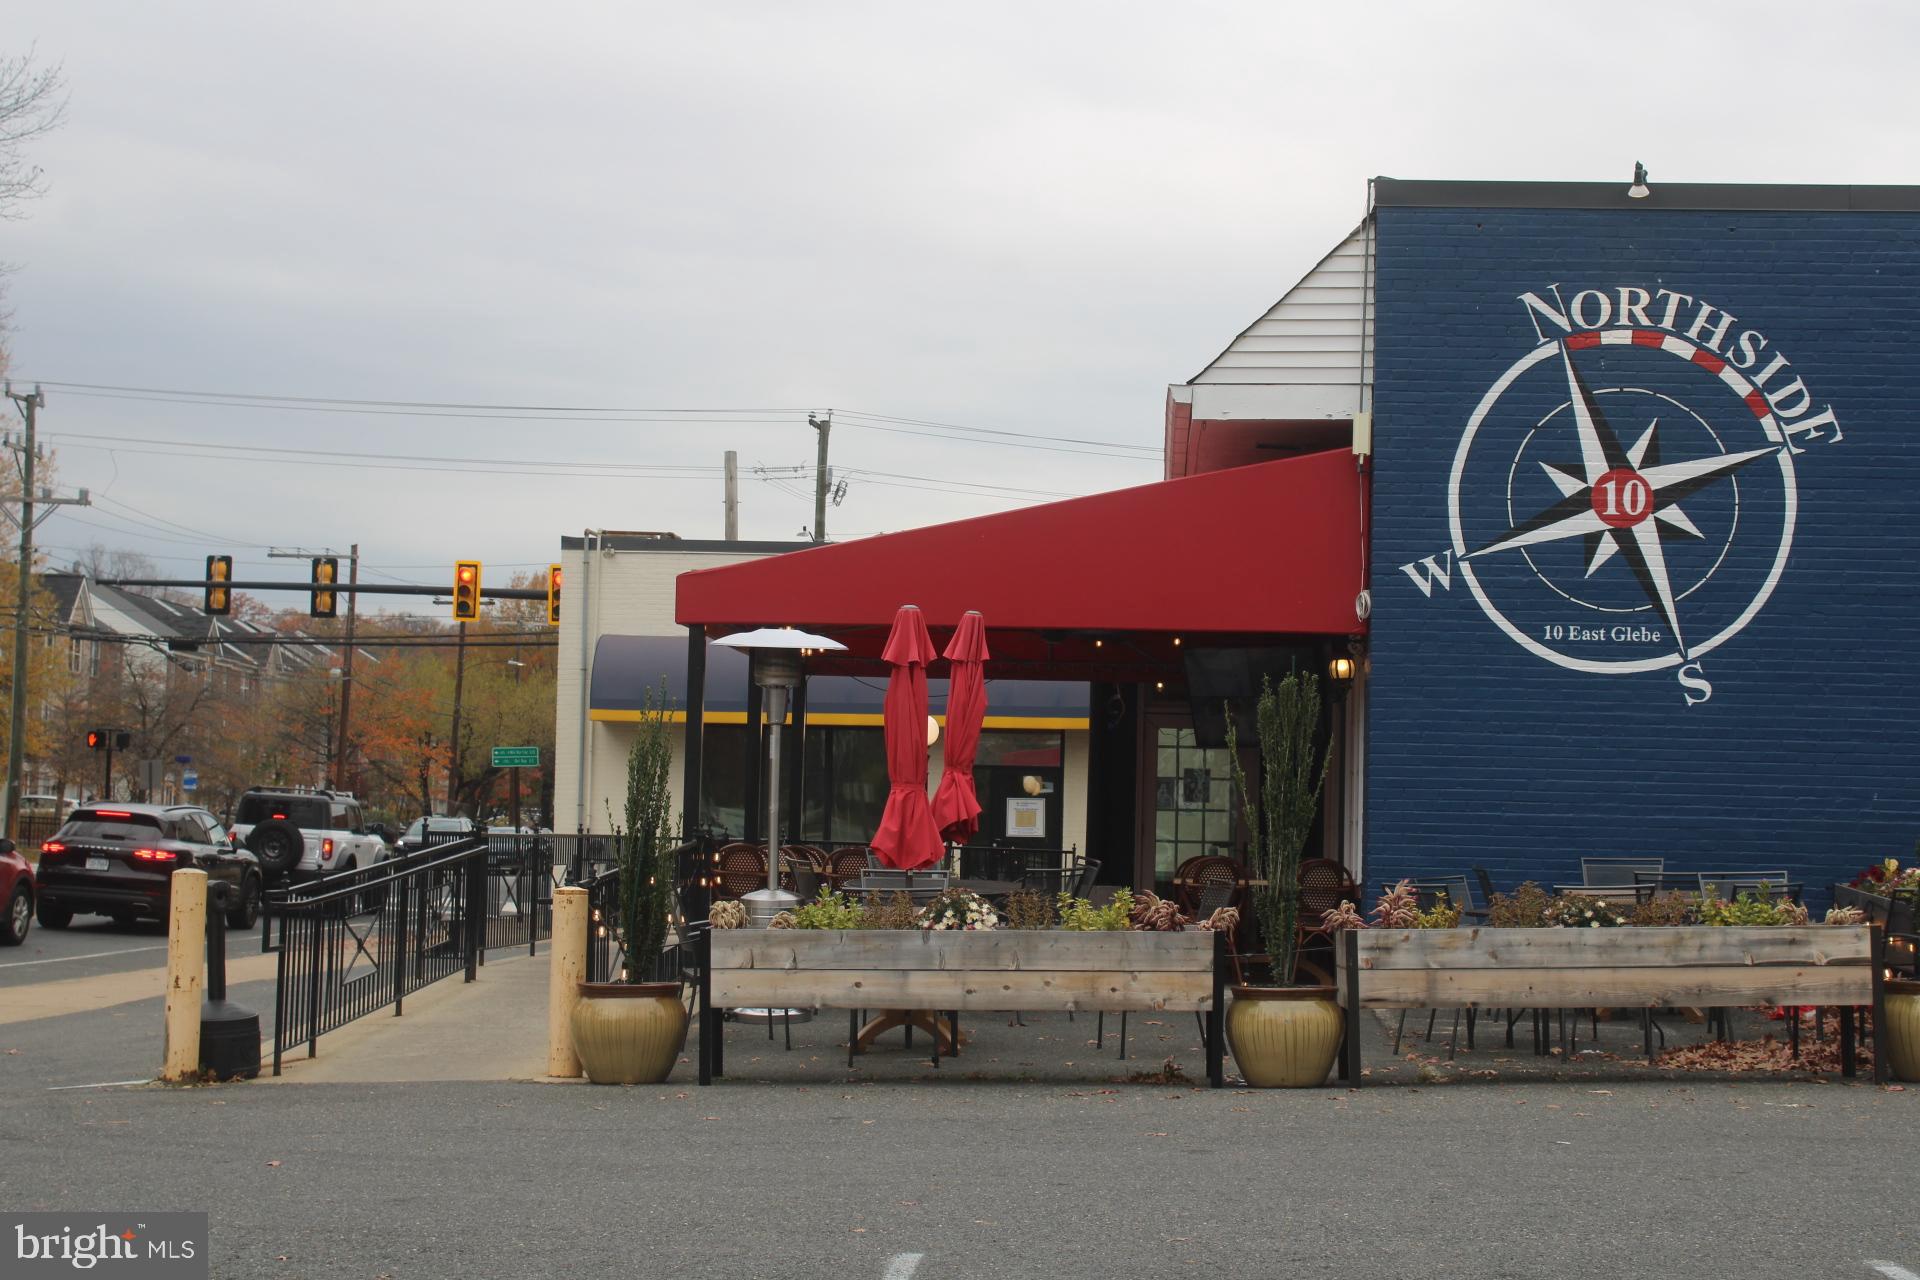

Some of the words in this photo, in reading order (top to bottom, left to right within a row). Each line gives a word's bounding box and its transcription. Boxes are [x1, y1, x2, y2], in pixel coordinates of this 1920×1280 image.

[1517, 283, 1843, 455] NORTHSIDE
[1601, 478, 1646, 515] 10
[1399, 549, 1456, 598] W
[1543, 625, 1563, 640] 10
[1568, 625, 1606, 641] East
[1611, 626, 1661, 642] Glebe
[1678, 661, 1713, 706] S
